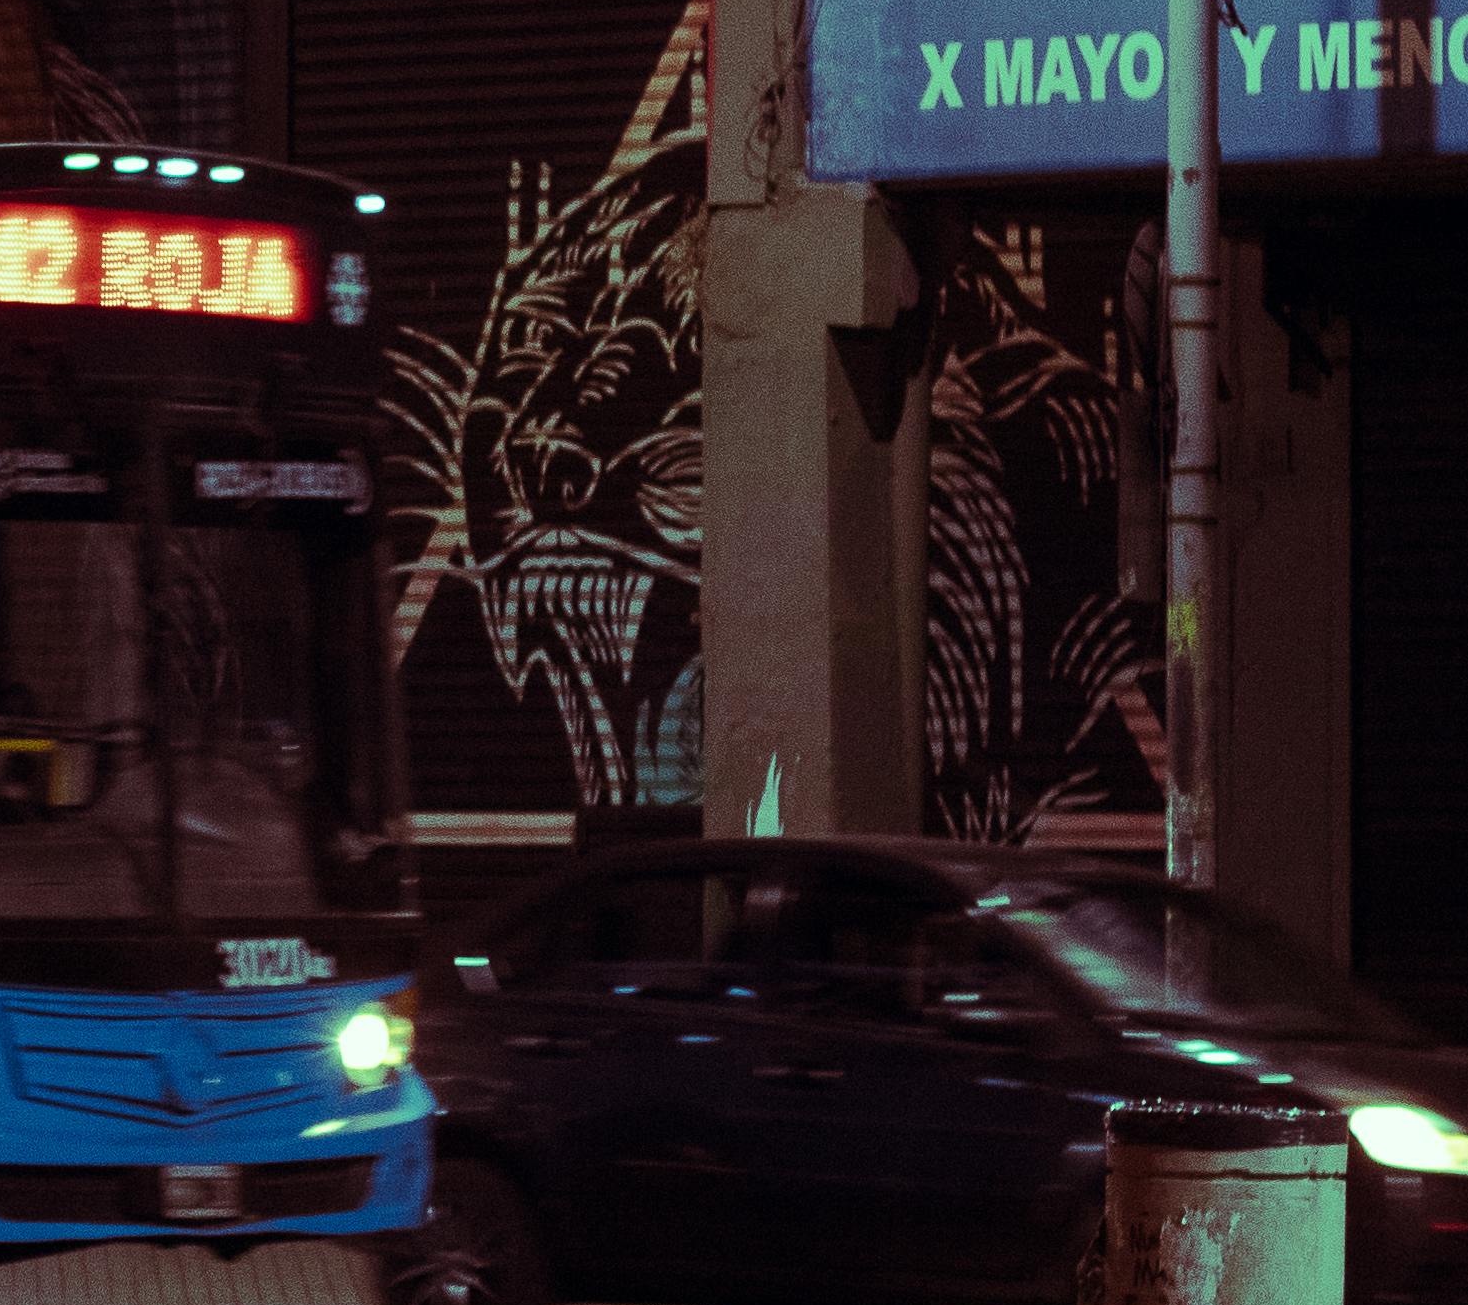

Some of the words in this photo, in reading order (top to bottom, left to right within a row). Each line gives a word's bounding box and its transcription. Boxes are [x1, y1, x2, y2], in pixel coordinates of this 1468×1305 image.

[919, 41, 964, 111] X
[984, 29, 1165, 108] MAYO
[1229, 23, 1278, 96] Y
